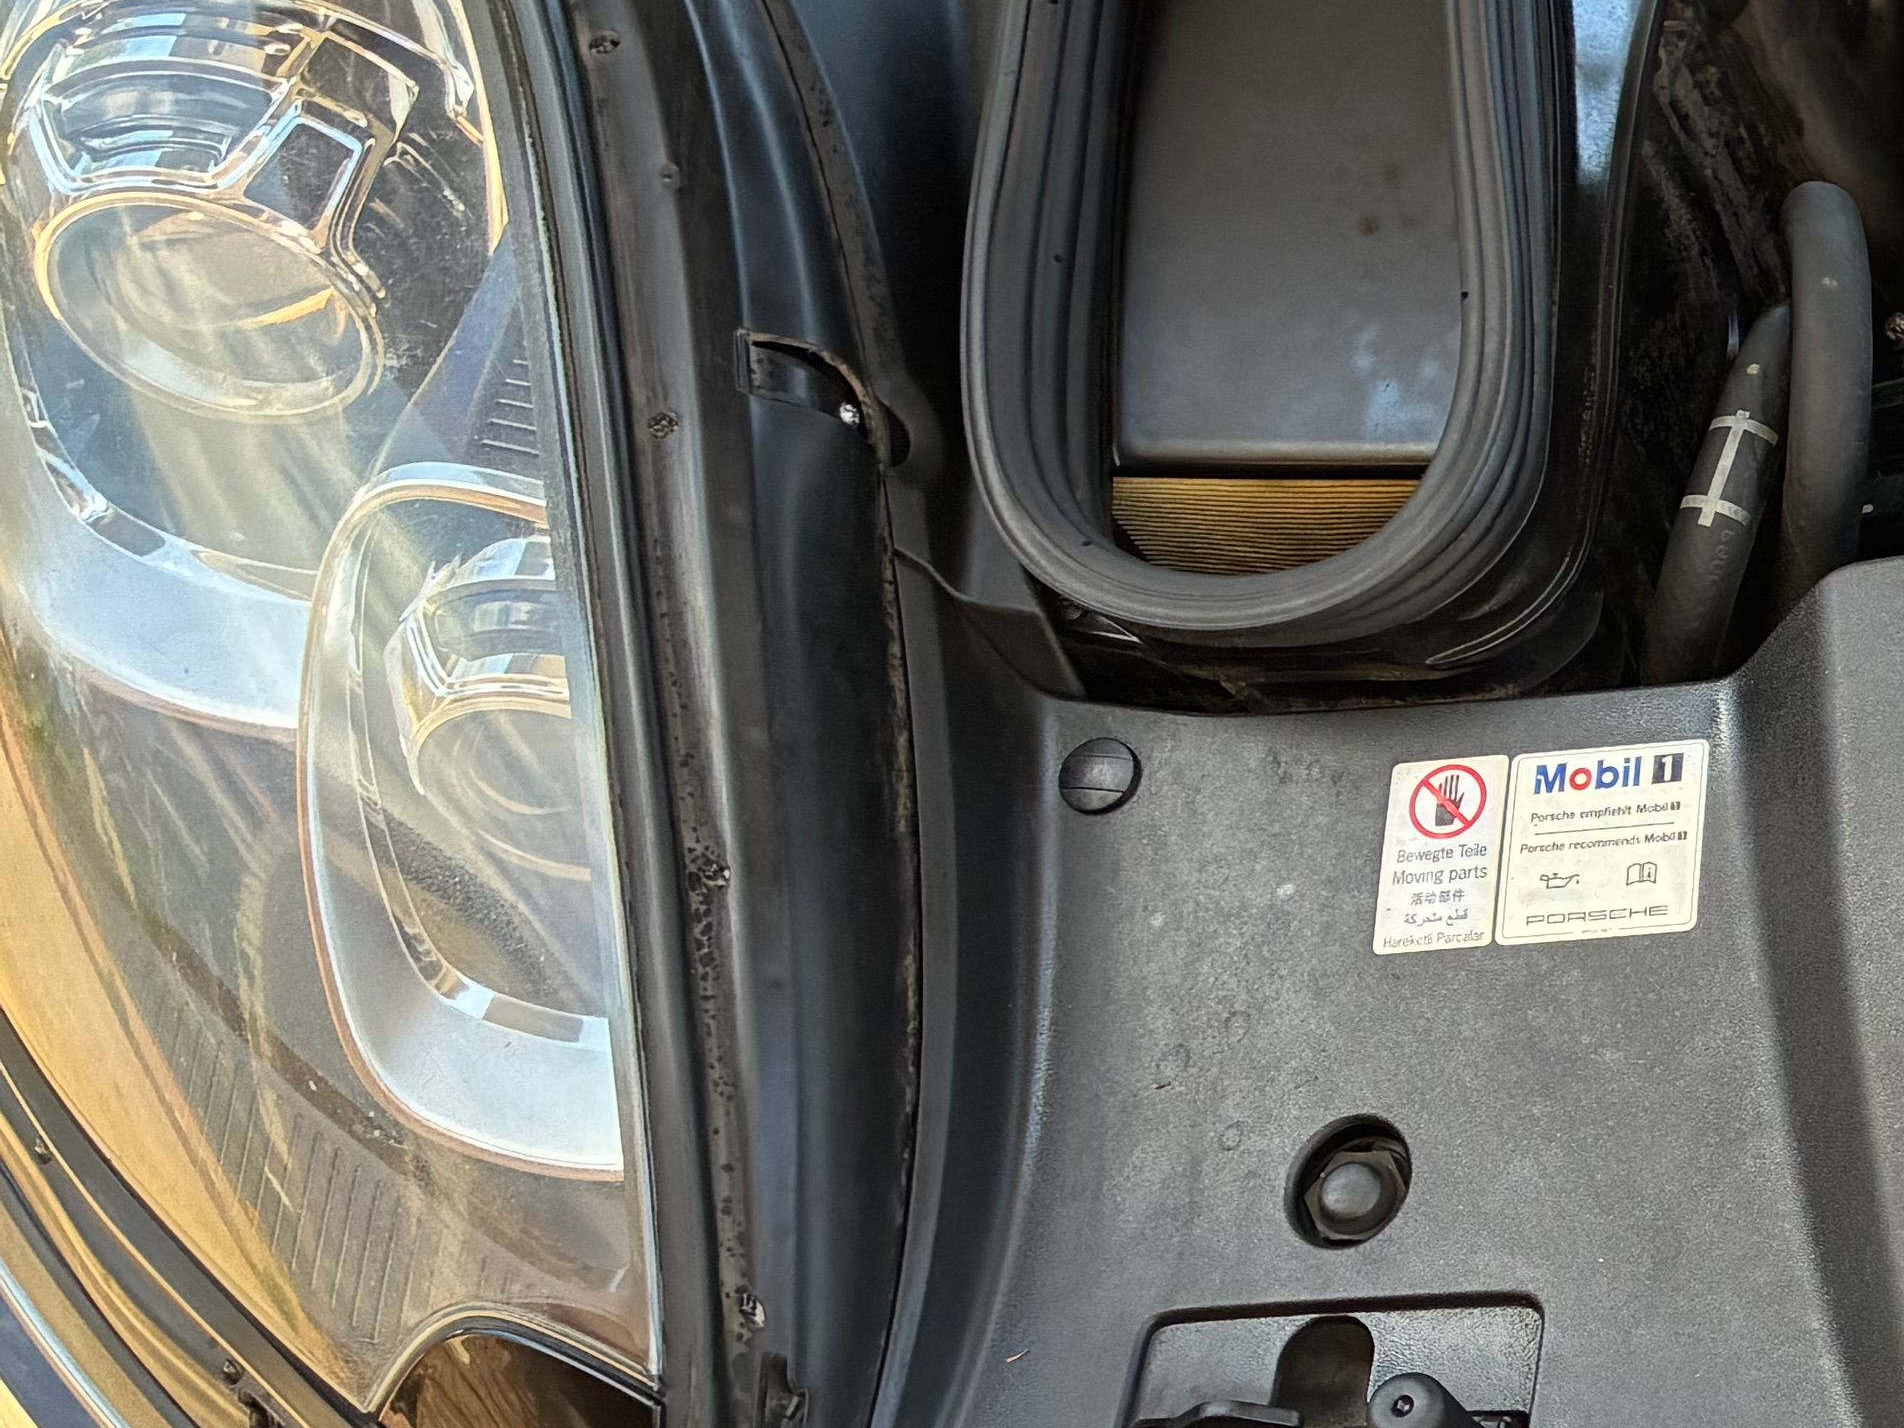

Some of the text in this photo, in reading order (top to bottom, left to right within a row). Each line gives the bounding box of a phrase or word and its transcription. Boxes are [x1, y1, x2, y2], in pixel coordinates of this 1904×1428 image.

[1533, 755, 1643, 796] Mobil
[1530, 810, 1576, 824] Porsche
[1396, 843, 1488, 864] Bewegte Teile
[1519, 841, 1566, 854] Porsche
[1568, 834, 1641, 851] recommends
[1392, 865, 1488, 886] Moving parts
[1525, 905, 1669, 927] PORSCHE
